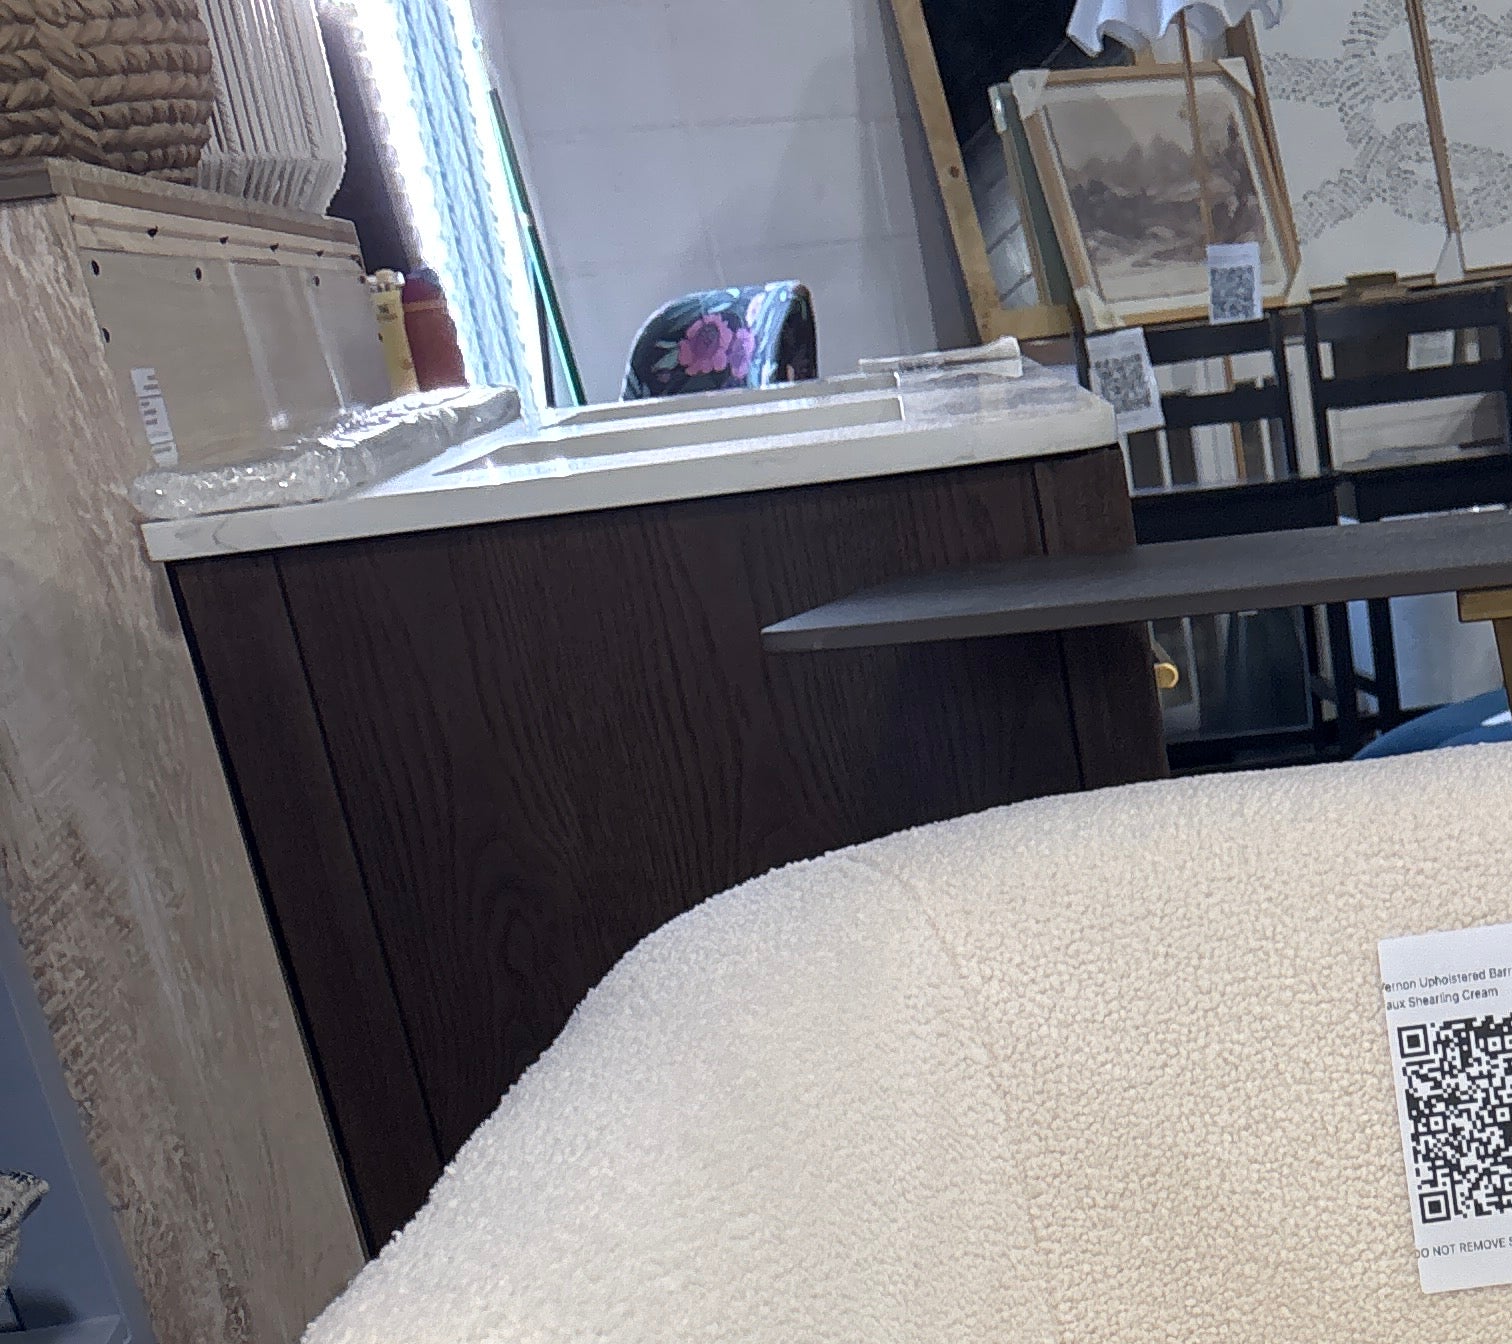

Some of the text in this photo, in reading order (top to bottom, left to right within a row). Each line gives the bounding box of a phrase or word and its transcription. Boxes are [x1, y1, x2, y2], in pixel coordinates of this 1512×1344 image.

[1419, 969, 1486, 989] Upholstered
[1408, 992, 1460, 1008] Shearling
[1462, 987, 1498, 1001] Cream
[1433, 1243, 1456, 1256] NOT
[1460, 1237, 1506, 1253] REMOVE
